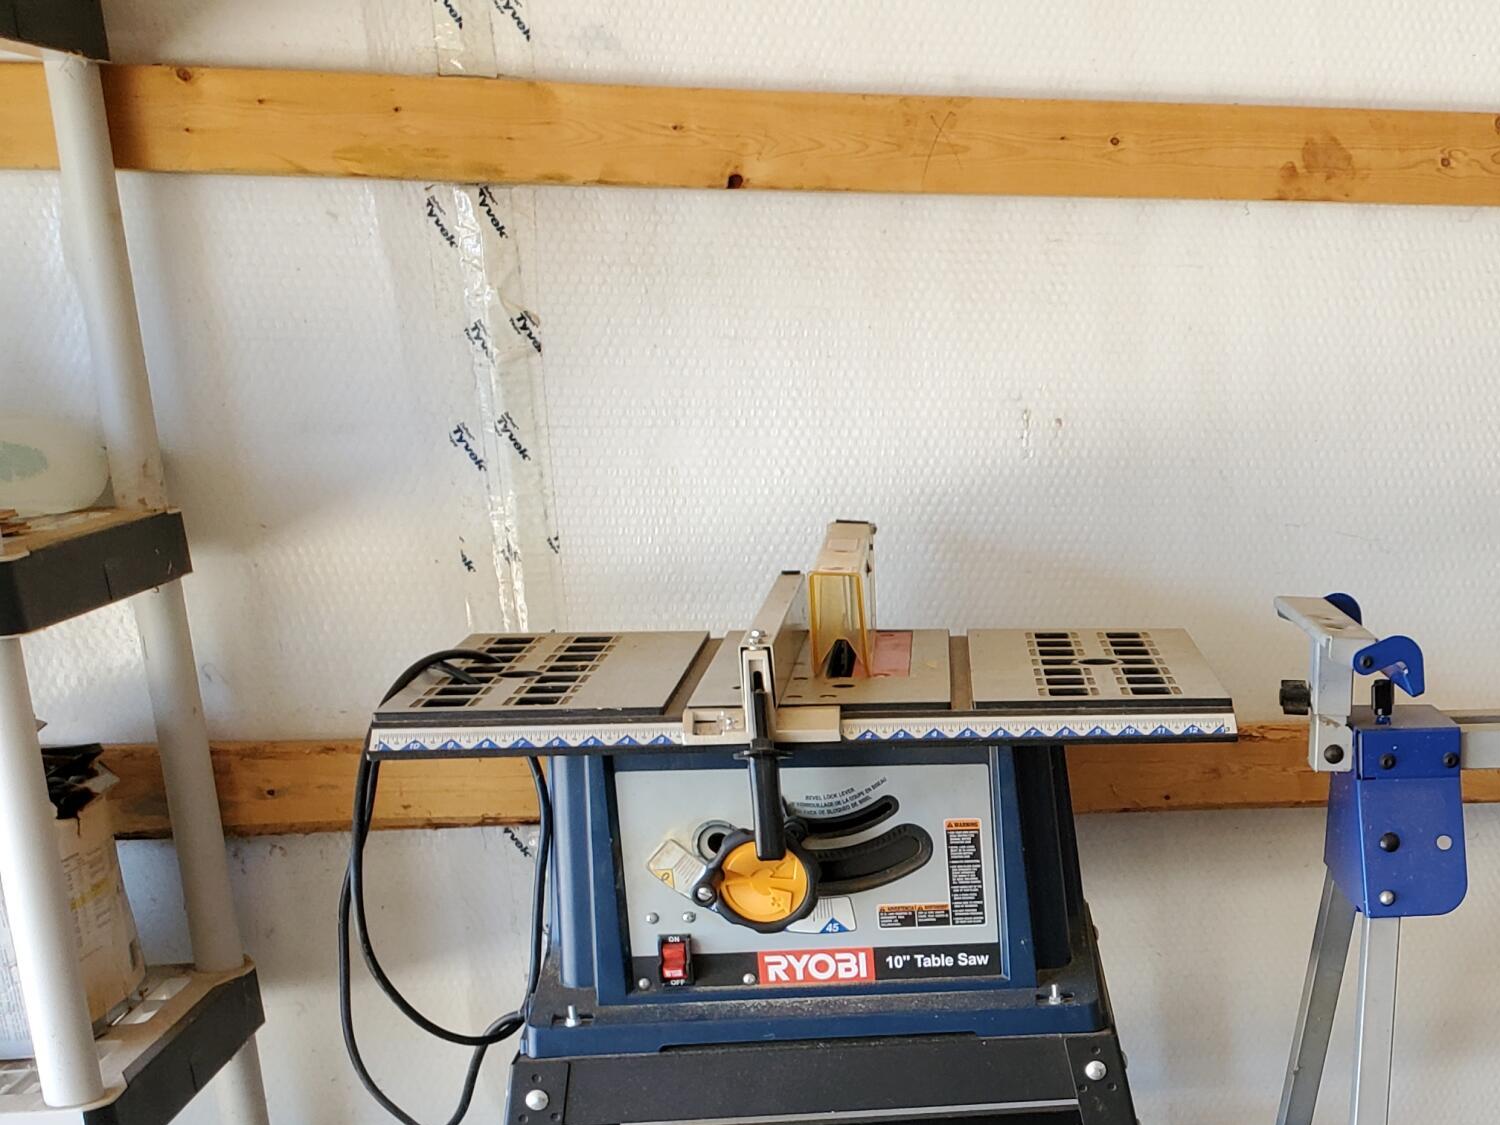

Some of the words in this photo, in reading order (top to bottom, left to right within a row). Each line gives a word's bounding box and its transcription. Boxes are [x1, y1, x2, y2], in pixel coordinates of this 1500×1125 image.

[426, 198, 458, 248] Tyvek
[516, 311, 542, 353] Tyve
[453, 424, 487, 472] Tyvek
[497, 414, 531, 461] Tyvek
[865, 732, 872, 740] 2
[825, 923, 839, 933] 45
[764, 952, 868, 982] RYOBI
[885, 954, 910, 969] 10"
[914, 953, 954, 968] Table
[957, 952, 989, 966] Saw
